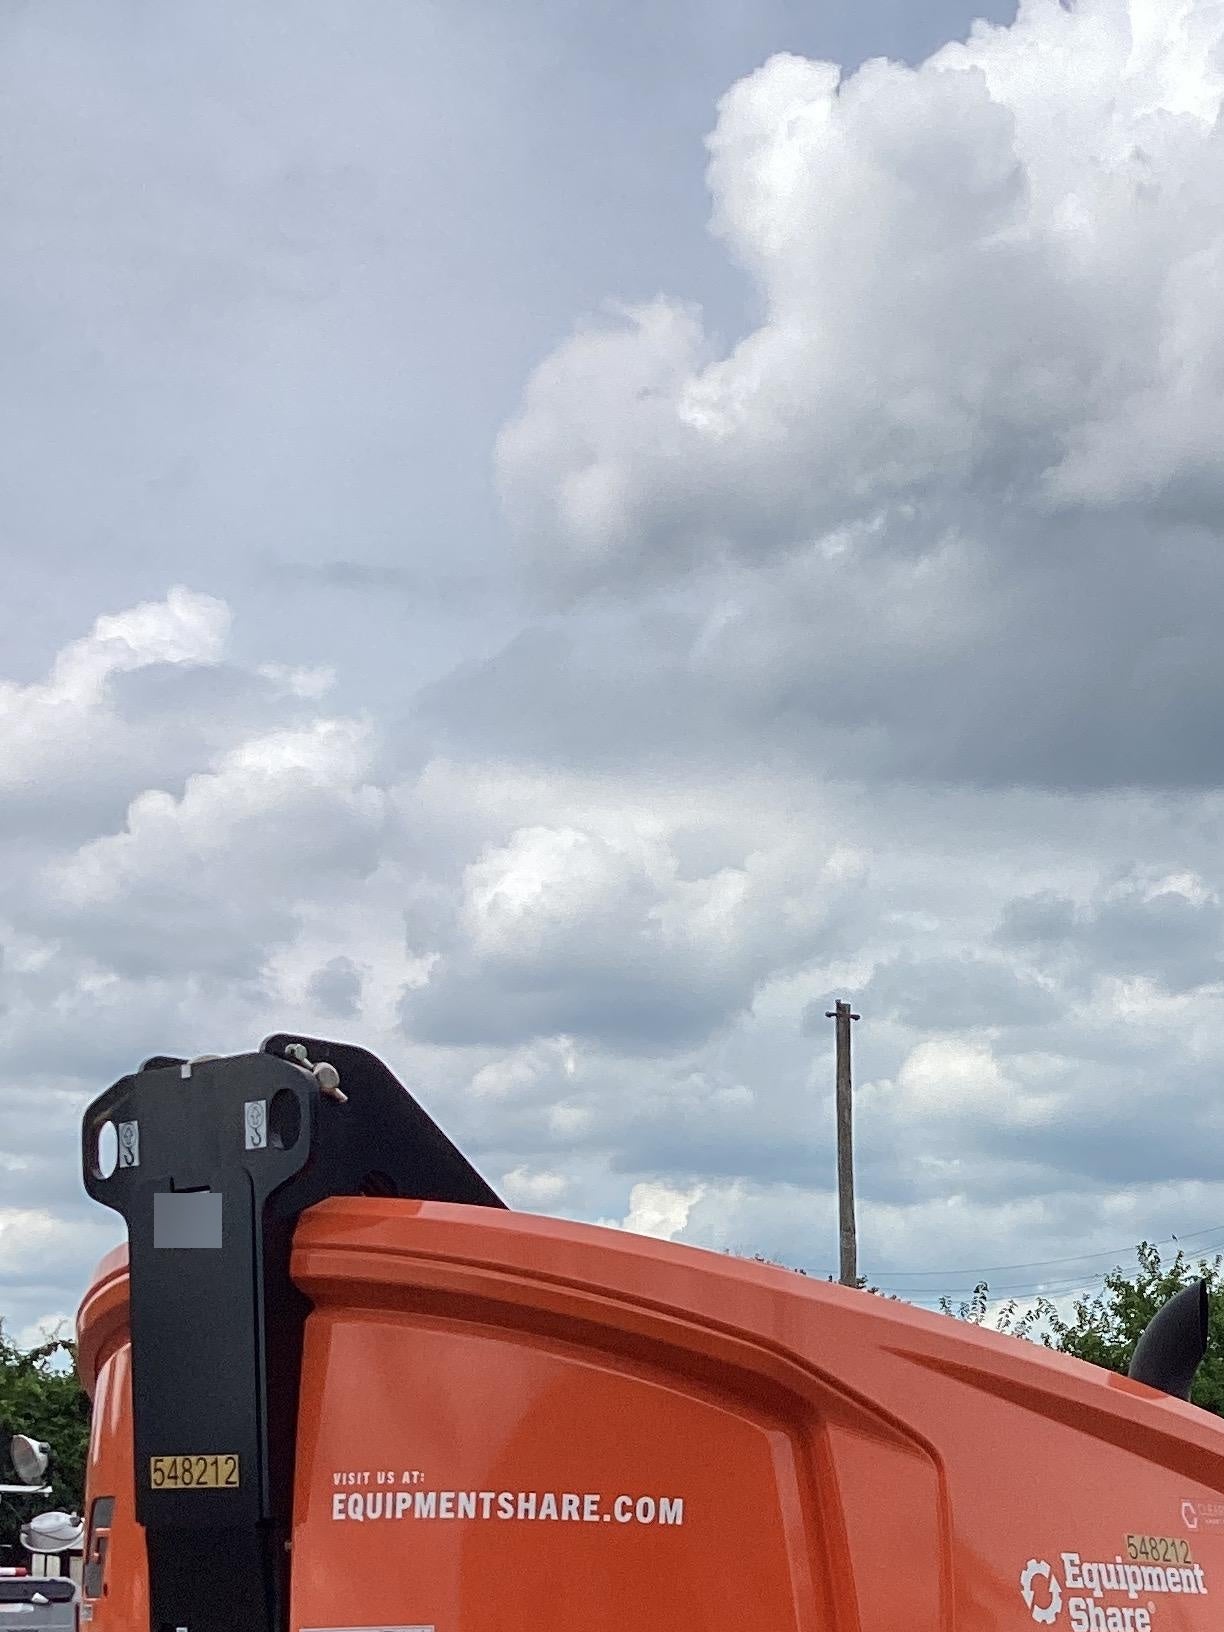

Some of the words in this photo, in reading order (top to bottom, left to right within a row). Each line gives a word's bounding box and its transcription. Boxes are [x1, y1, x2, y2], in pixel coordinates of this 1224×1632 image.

[152, 1457, 238, 1486] 548212
[333, 1471, 370, 1485] VISIT
[377, 1470, 395, 1484] US
[402, 1470, 425, 1484] AT:
[332, 1491, 684, 1525] EQUIPMENTSHARE.COM
[1126, 1535, 1192, 1565] 548212
[1060, 1552, 1208, 1599] Equipment
